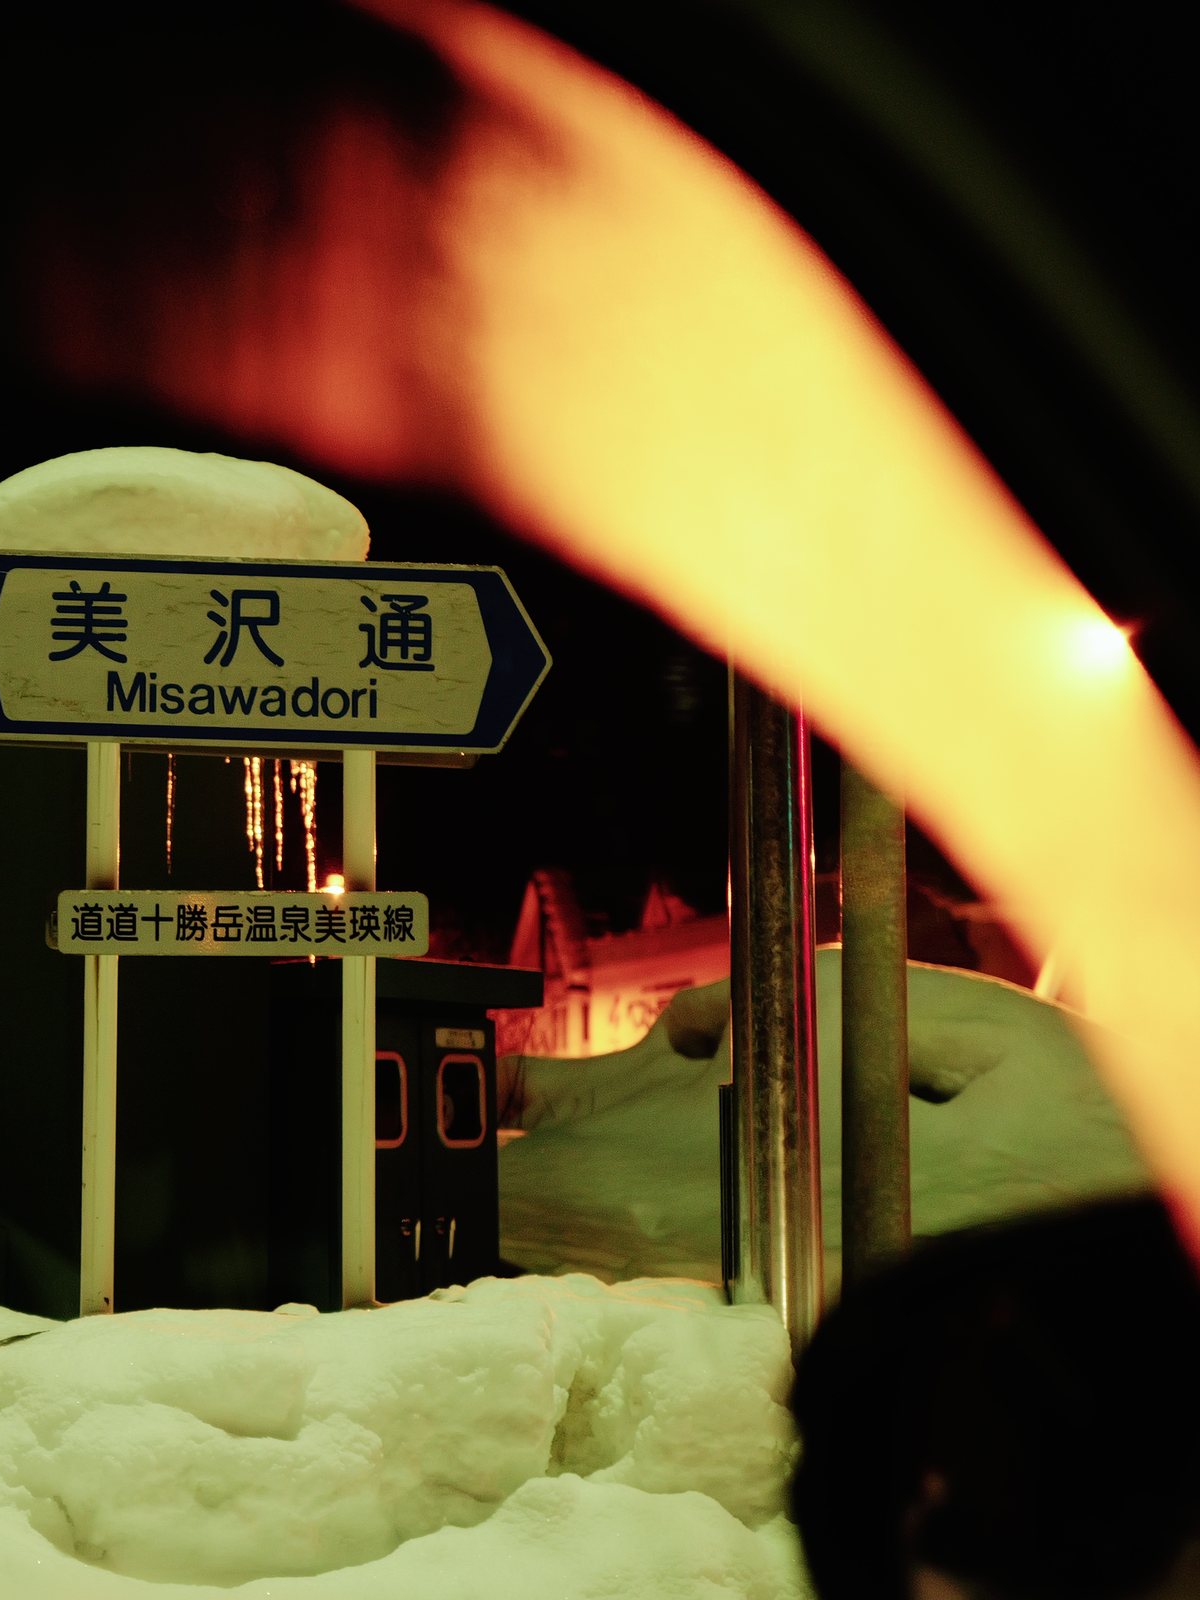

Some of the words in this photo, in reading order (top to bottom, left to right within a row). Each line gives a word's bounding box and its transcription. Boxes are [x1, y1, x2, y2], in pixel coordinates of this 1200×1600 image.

[48, 581, 436, 672] 美沢通
[106, 671, 378, 719] Misawadori
[71, 903, 416, 944] 道道十勝岳温泉美瑛線
